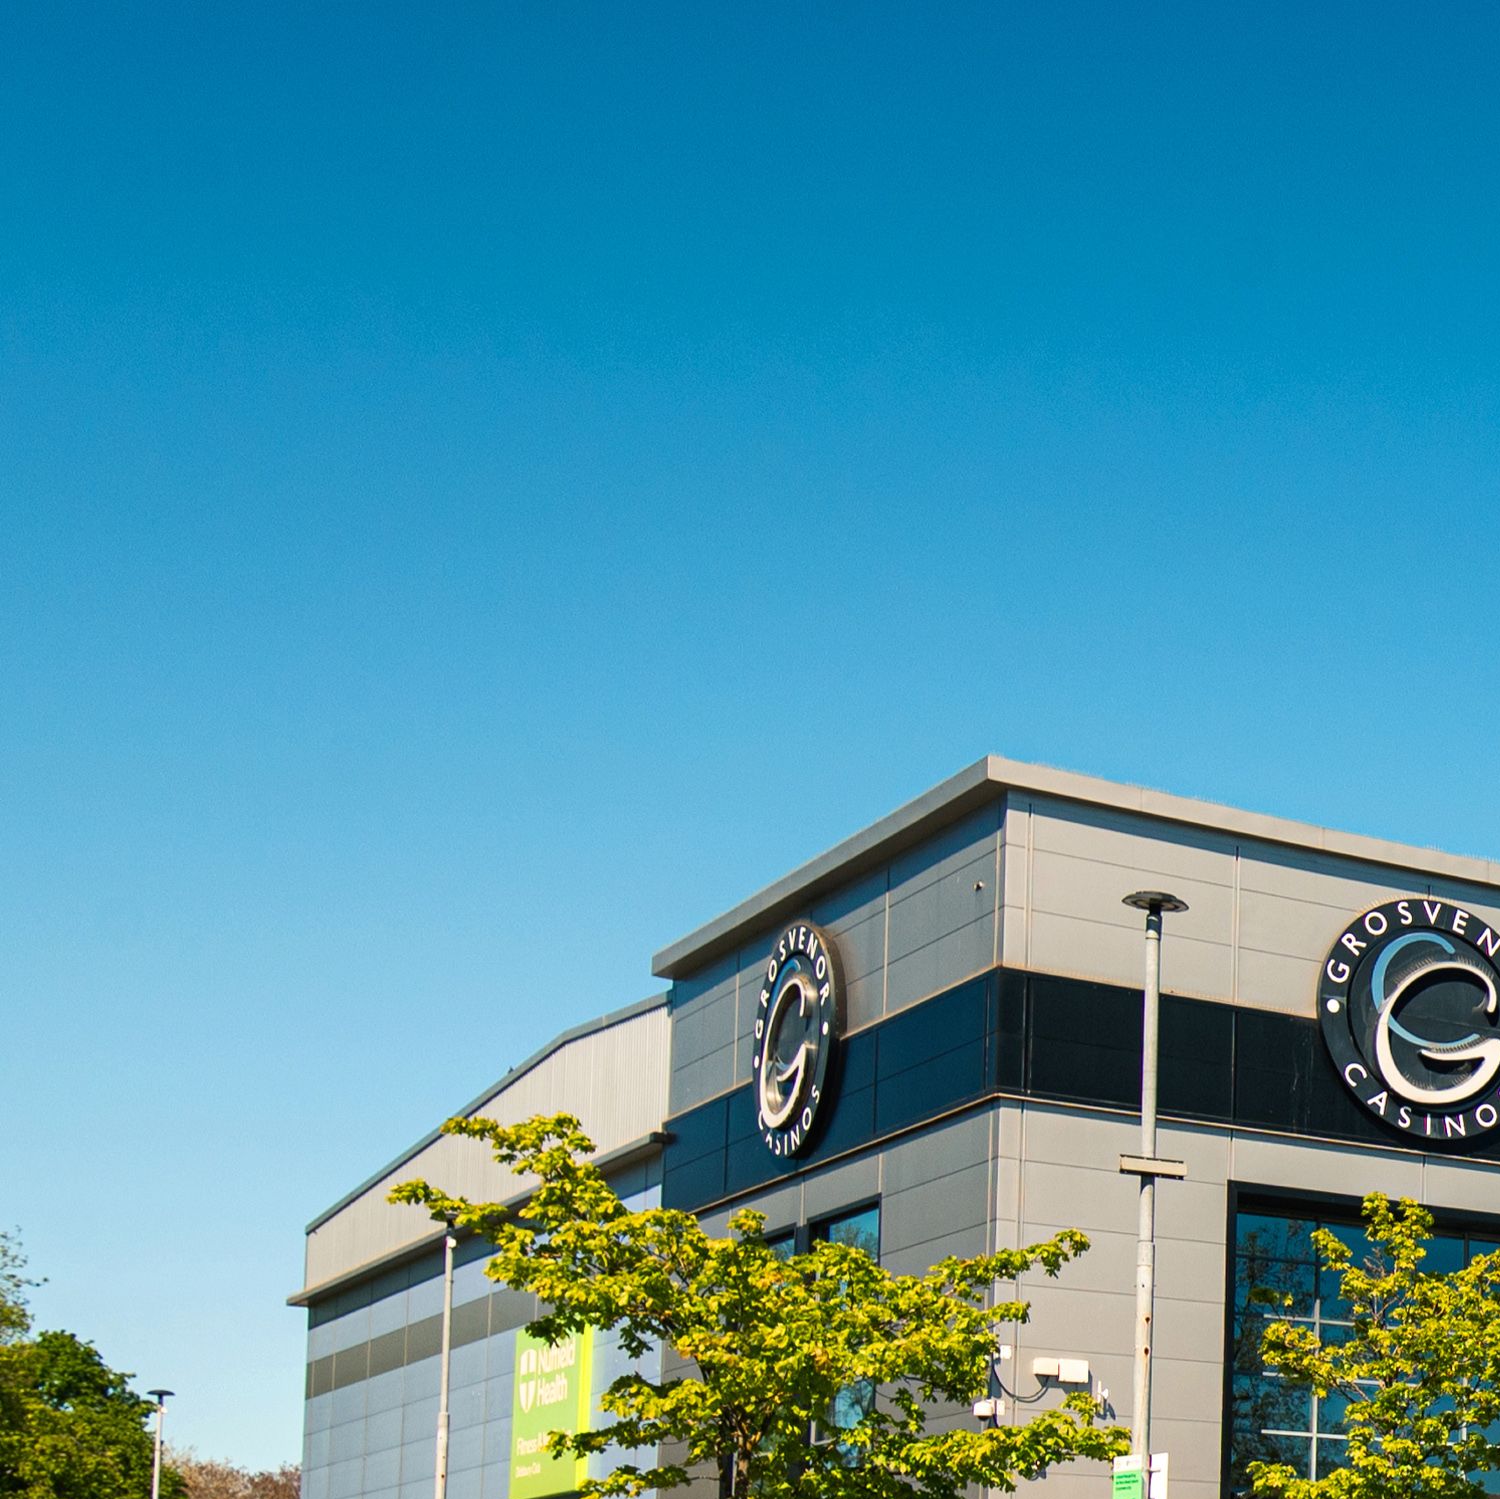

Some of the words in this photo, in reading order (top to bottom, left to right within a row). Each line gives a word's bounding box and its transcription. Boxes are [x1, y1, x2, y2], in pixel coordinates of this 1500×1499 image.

[754, 927, 830, 1039] GROSVENOR
[758, 1088, 821, 1158] CASINOS
[536, 1372, 568, 1407] Health
